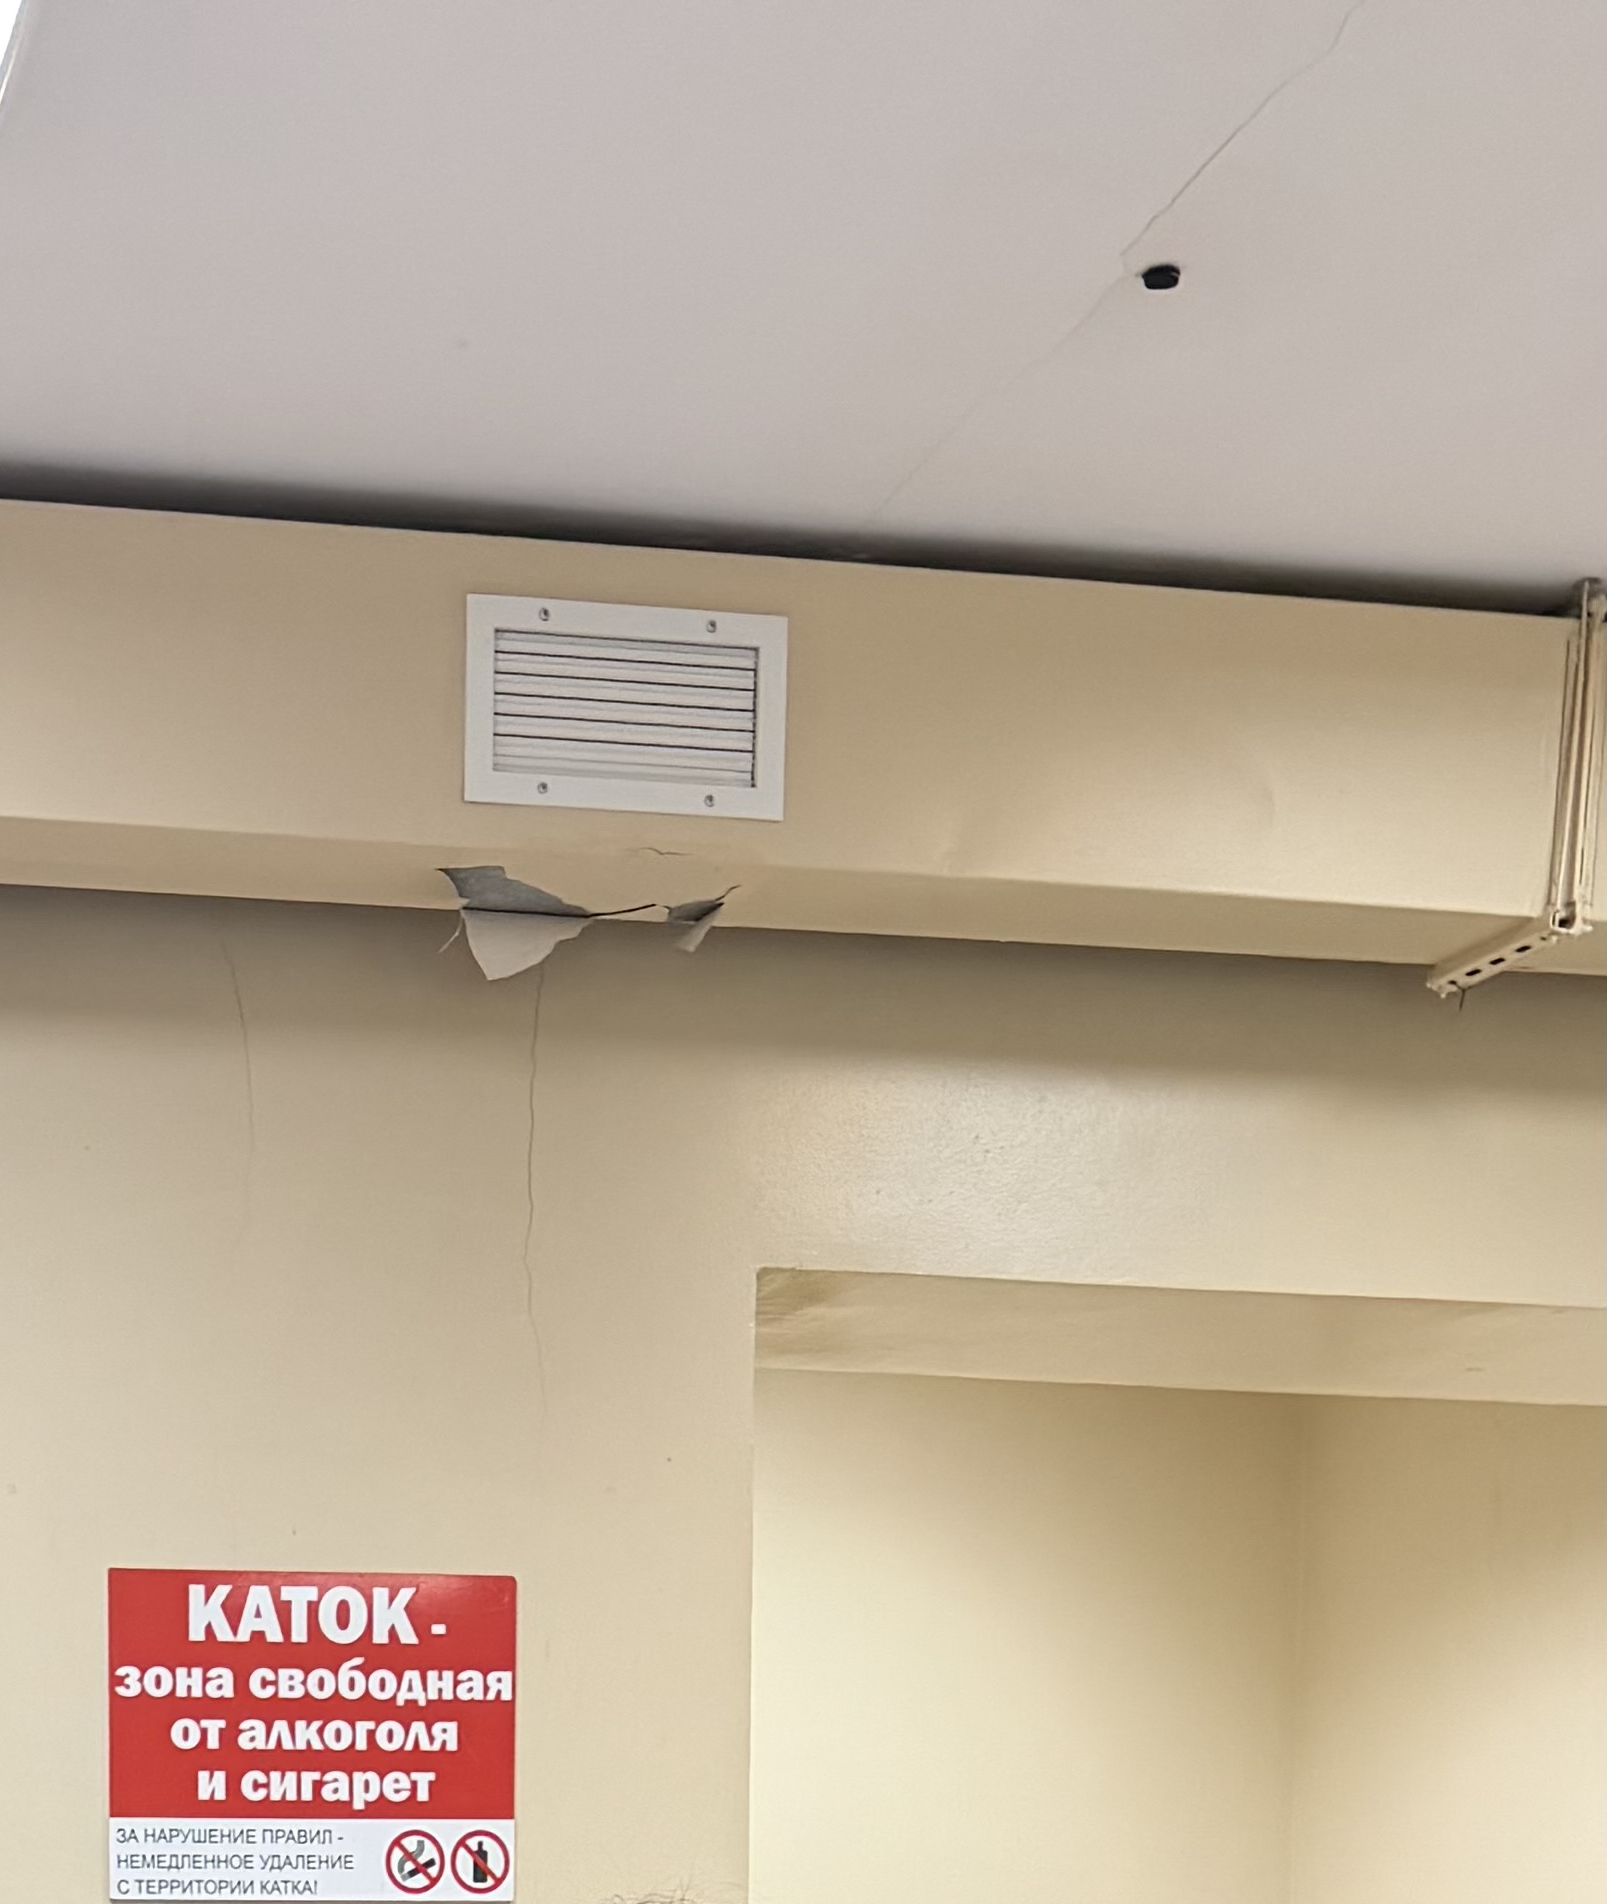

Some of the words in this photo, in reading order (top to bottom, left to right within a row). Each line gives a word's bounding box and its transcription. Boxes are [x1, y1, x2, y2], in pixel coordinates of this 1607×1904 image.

[187, 1583, 420, 1645] КАТОК
[113, 1665, 235, 1699] зона
[248, 1657, 514, 1707] свободная
[169, 1718, 226, 1750] от
[237, 1719, 459, 1752] алкоголя
[197, 1770, 227, 1801] и
[240, 1770, 437, 1810] сигарет
[116, 1828, 140, 1845] ЗА
[144, 1828, 258, 1846] НАРУШЕНИЕ
[261, 1829, 334, 1846] ПРАВИЛ
[116, 1853, 256, 1873] НЕМЕДЛЕННОЕ
[259, 1854, 355, 1873] УДАЛЕНИЕ
[116, 1879, 132, 1895] С
[134, 1879, 256, 1896] ТЕРРИТОРИИ
[259, 1880, 319, 1896] КАТКА!
